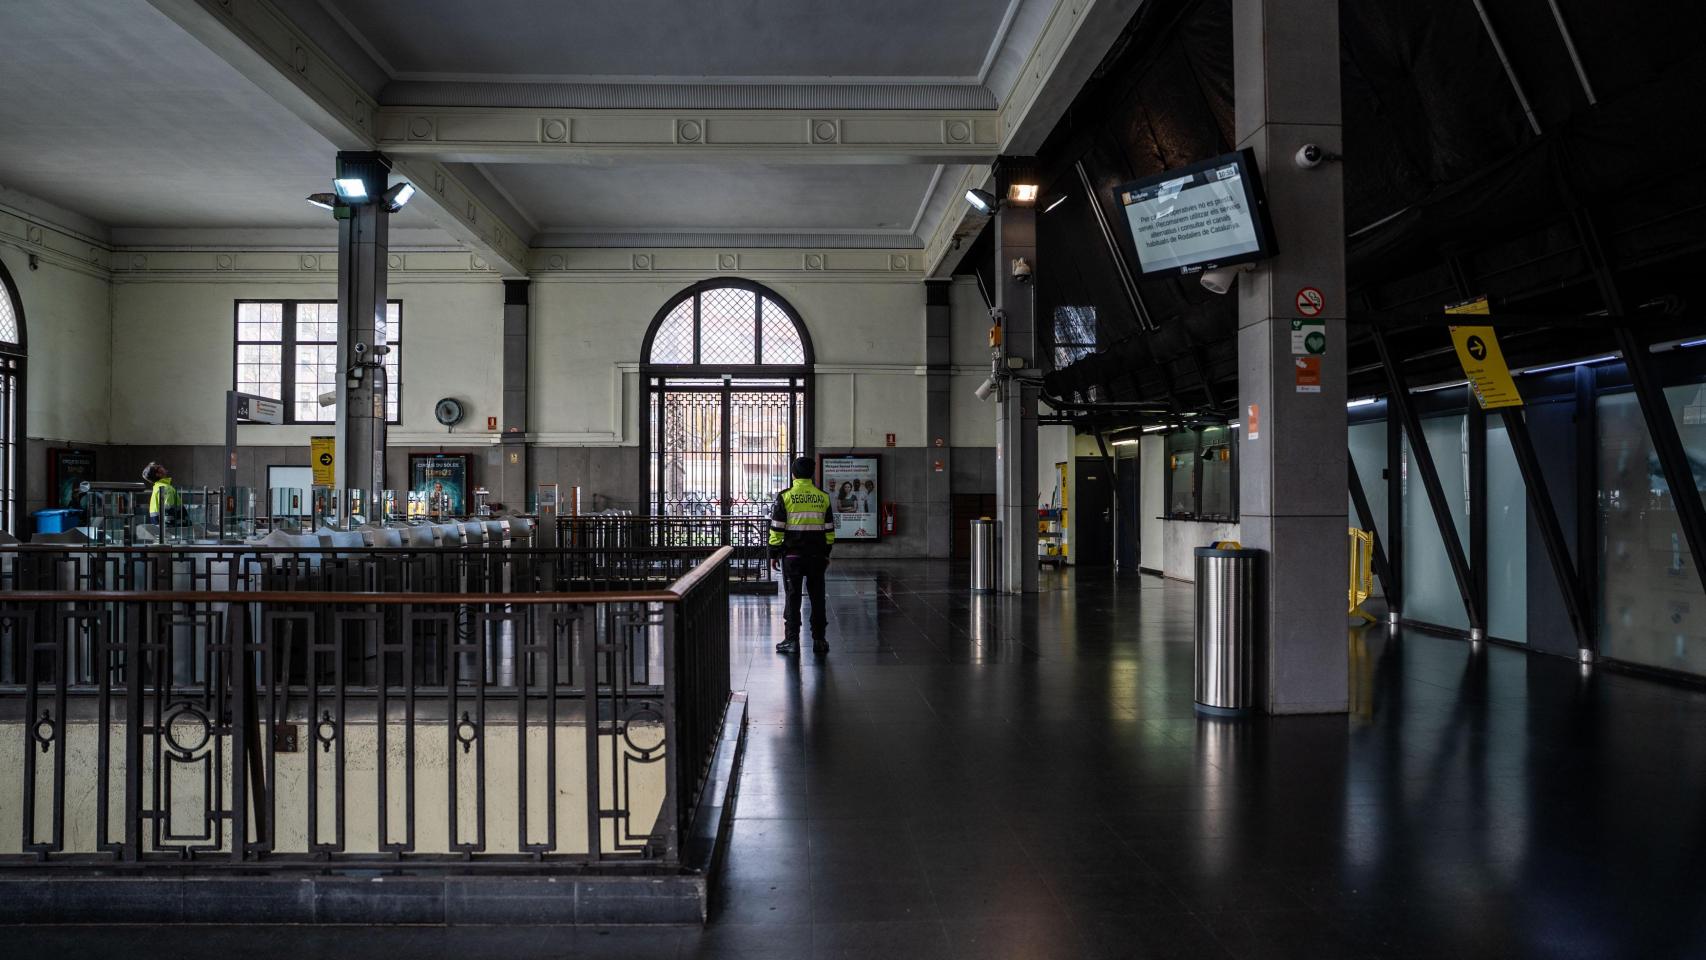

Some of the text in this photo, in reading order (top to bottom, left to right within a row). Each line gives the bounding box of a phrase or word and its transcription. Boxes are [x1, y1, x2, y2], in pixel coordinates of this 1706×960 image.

[1218, 170, 1234, 178] 10:55
[1170, 205, 1197, 217] operatives
[1156, 216, 1189, 228] Recomanem
[1190, 211, 1209, 220] utilitzar
[1150, 228, 1177, 238] alternatius
[1180, 221, 1205, 231] consultar
[1212, 215, 1231, 223] canals
[1178, 231, 1201, 240] Rodalies
[791, 494, 825, 504] SEGURIDAD
